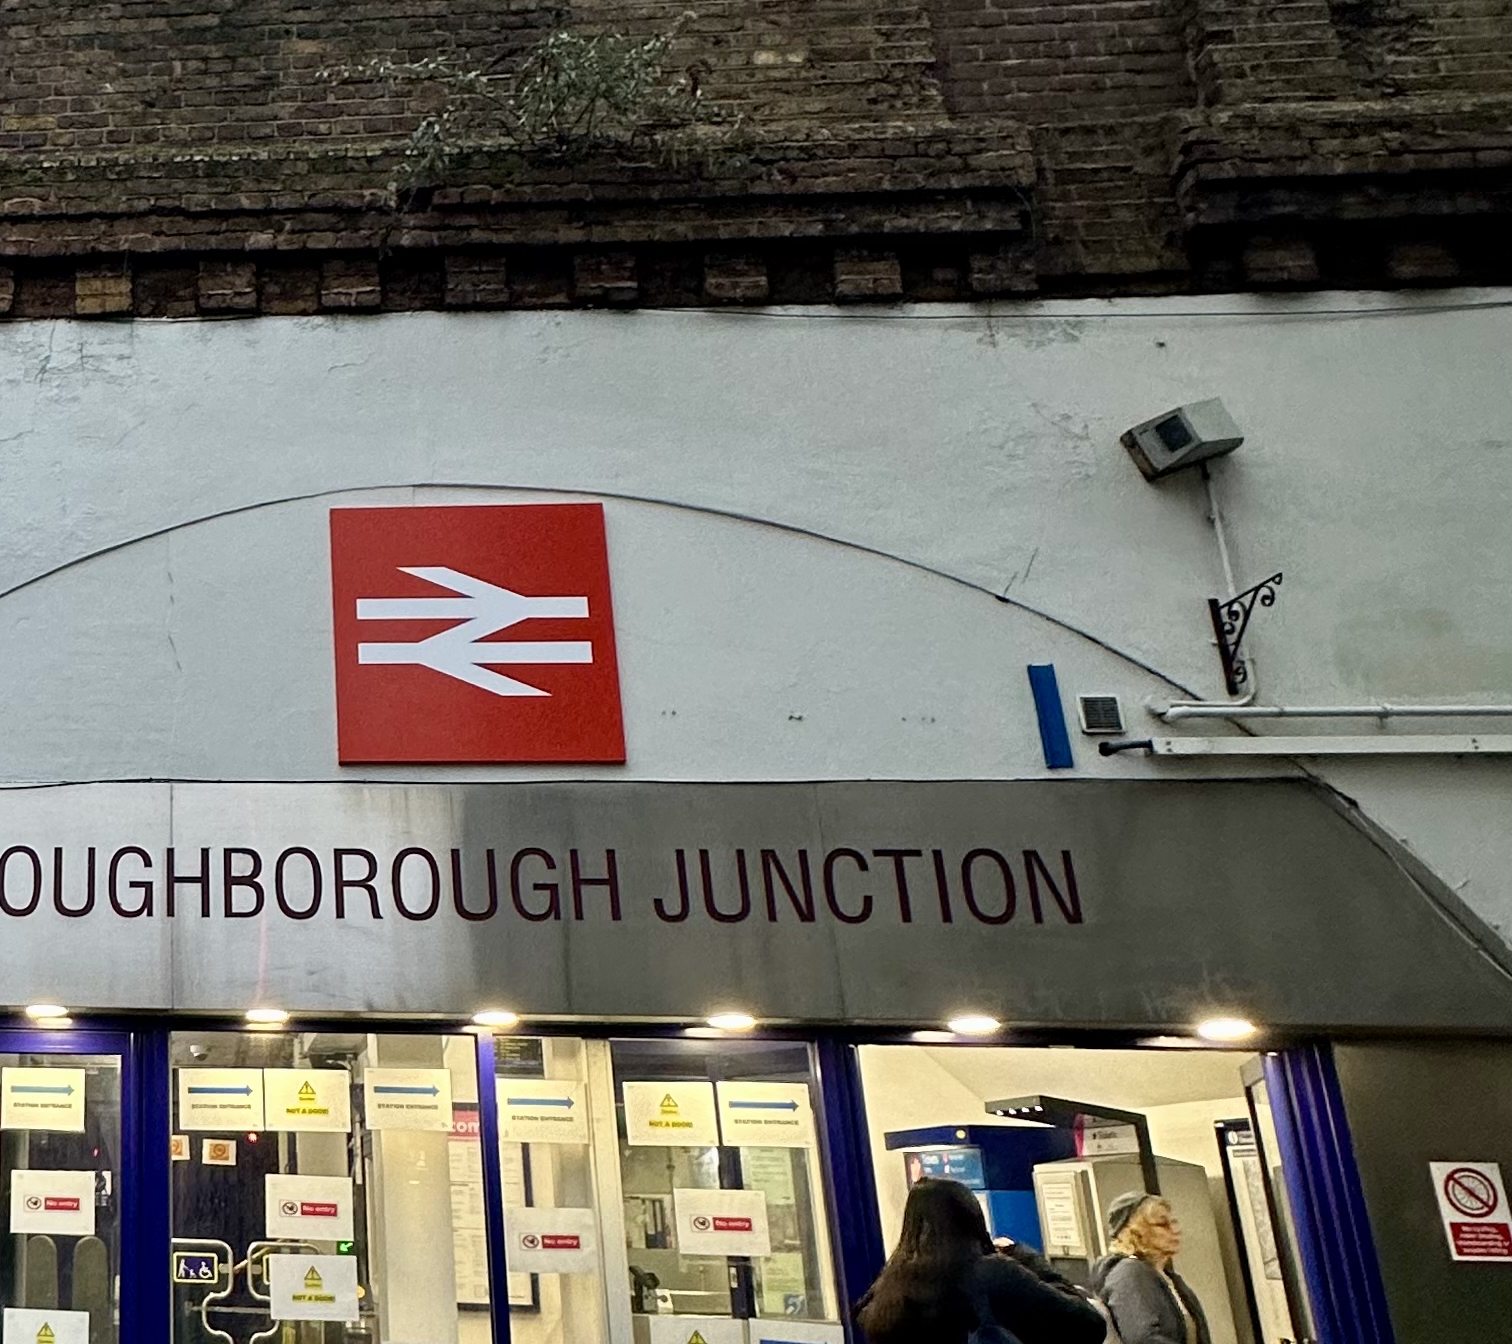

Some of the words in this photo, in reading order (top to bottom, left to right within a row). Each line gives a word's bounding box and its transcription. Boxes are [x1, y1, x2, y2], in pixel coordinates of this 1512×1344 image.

[653, 847, 1085, 926] JUNCTION
[58, 1200, 78, 1208] entry
[314, 1206, 336, 1215] entry
[727, 1220, 751, 1231] entry
[555, 1238, 579, 1248] entry
